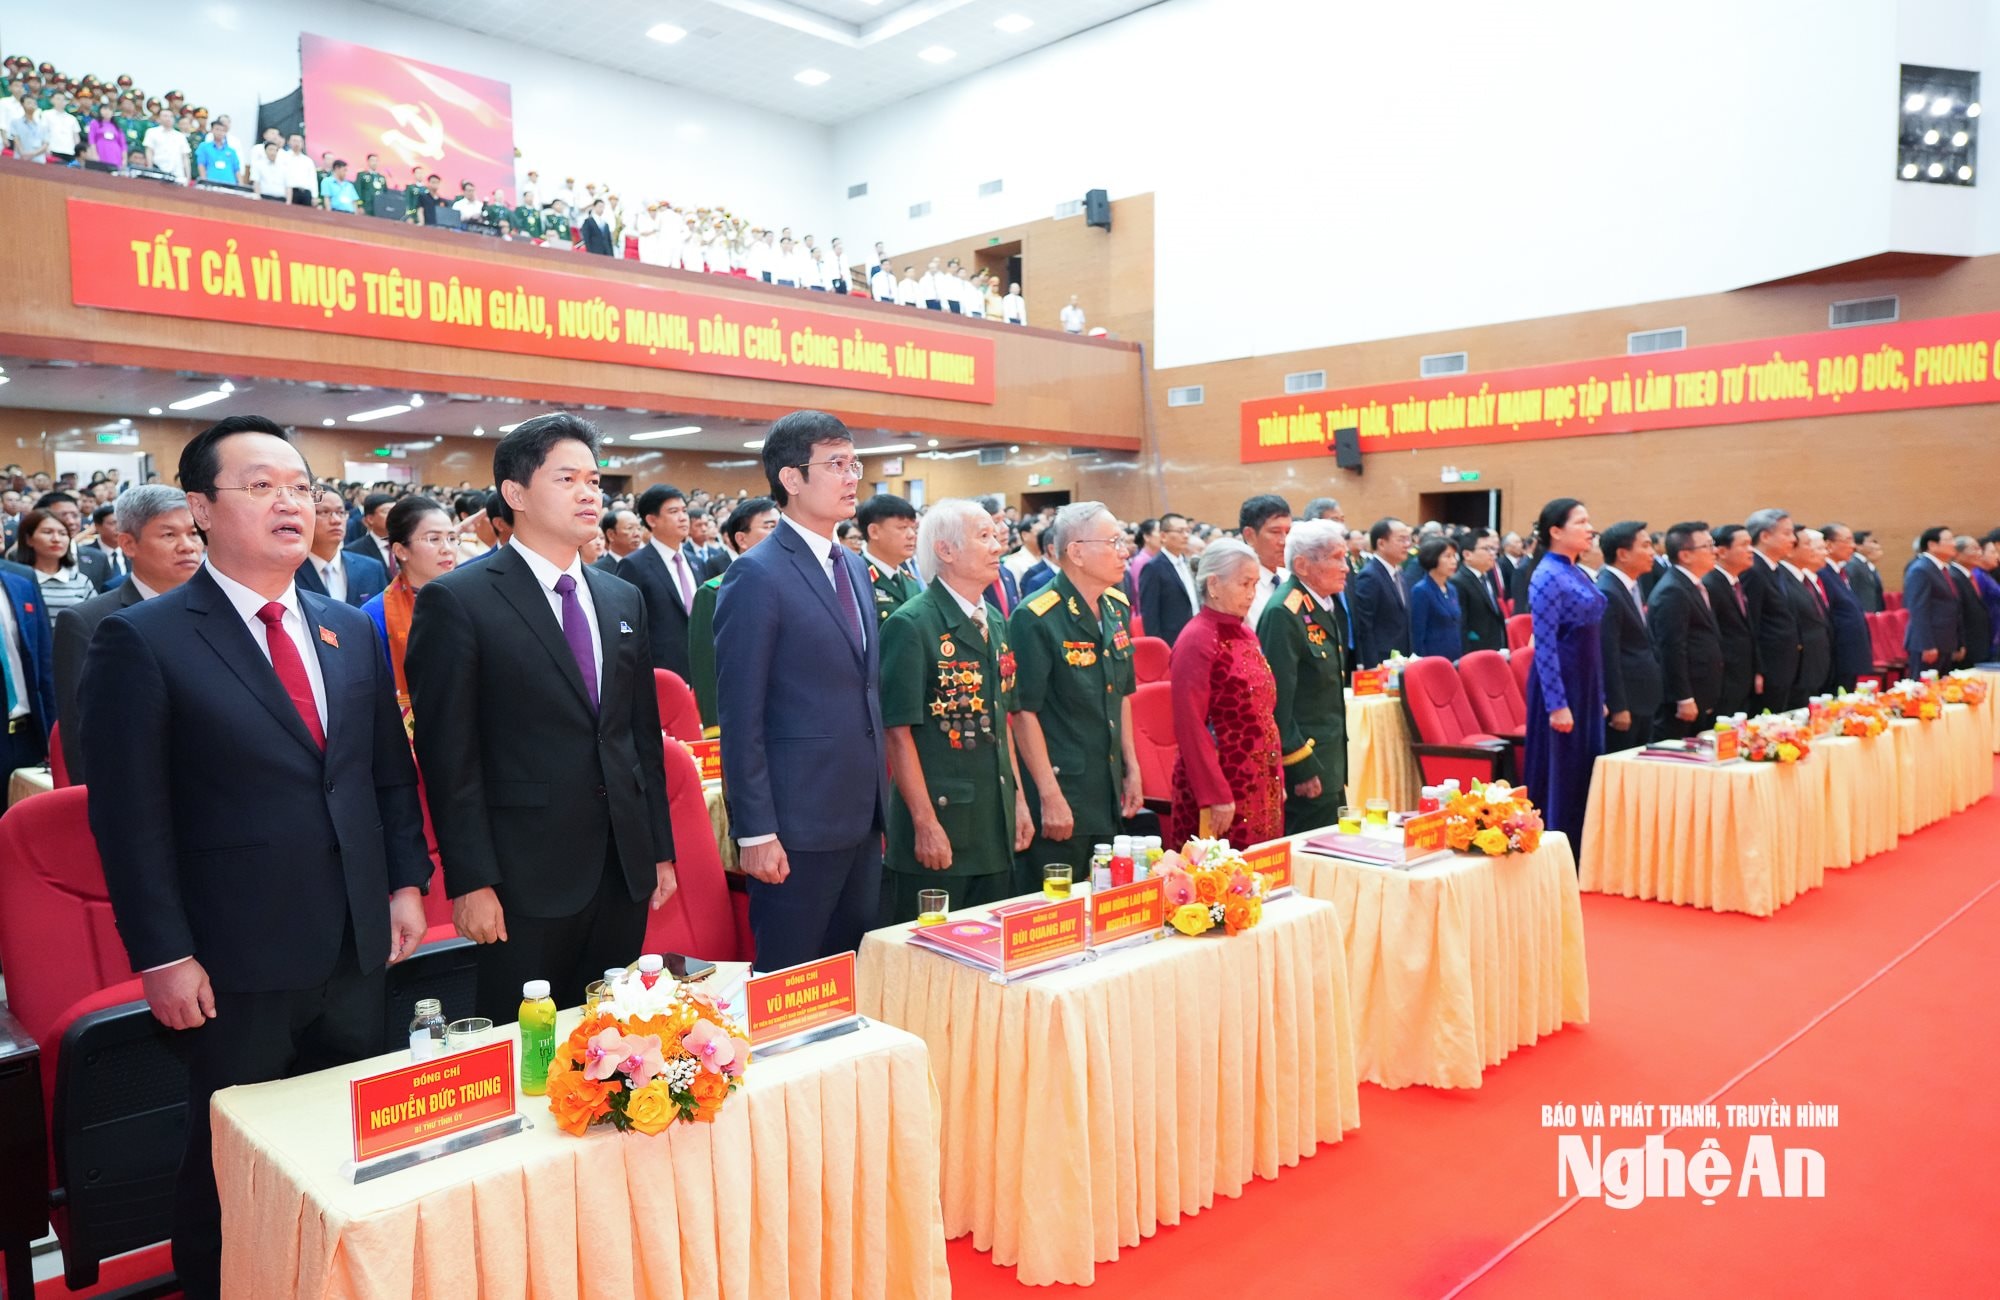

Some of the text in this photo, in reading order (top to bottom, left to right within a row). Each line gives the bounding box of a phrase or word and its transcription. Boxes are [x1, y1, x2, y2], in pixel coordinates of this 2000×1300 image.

[131, 229, 975, 385] TẤT CẢ VÌ MỤC TIÊU DÂN GIÀU, NƯỚC MẠNH, DÂN CHỦ, CÔNG BẰNG, VĂN MINH!
[1258, 410, 1289, 446] TOÀN
[1392, 396, 1427, 434] TOÀN
[1428, 391, 1465, 435] QUÂN
[1466, 382, 1496, 428] ĐẨY
[1497, 388, 1543, 431] MẠNH
[1544, 385, 1576, 427] HỌC
[1578, 376, 1609, 424] TẬP
[1610, 372, 1633, 414] VÀ
[1634, 370, 1673, 412] LÀM
[1675, 371, 1718, 409] THEO
[1721, 364, 1747, 405] TƯ
[1748, 351, 1814, 402] TƯỞNG,
[1817, 355, 1858, 402] ĐẠO
[1862, 343, 1909, 392] ĐỨC,
[1914, 341, 1988, 387] PHONG
[1012, 928, 1028, 946] BÙI
[1029, 923, 1059, 943] QUANG
[1060, 918, 1077, 934] HUY
[767, 978, 838, 1014] VŨ MẠNH HÀ
[413, 1065, 461, 1088] ĐỒNG CHÍ
[370, 1076, 501, 1130] NGUYỄN ĐỨC TRUNG
[414, 1124, 422, 1134] BÍ
[422, 1121, 436, 1132] THƯ
[437, 1117, 453, 1129] TỈNH
